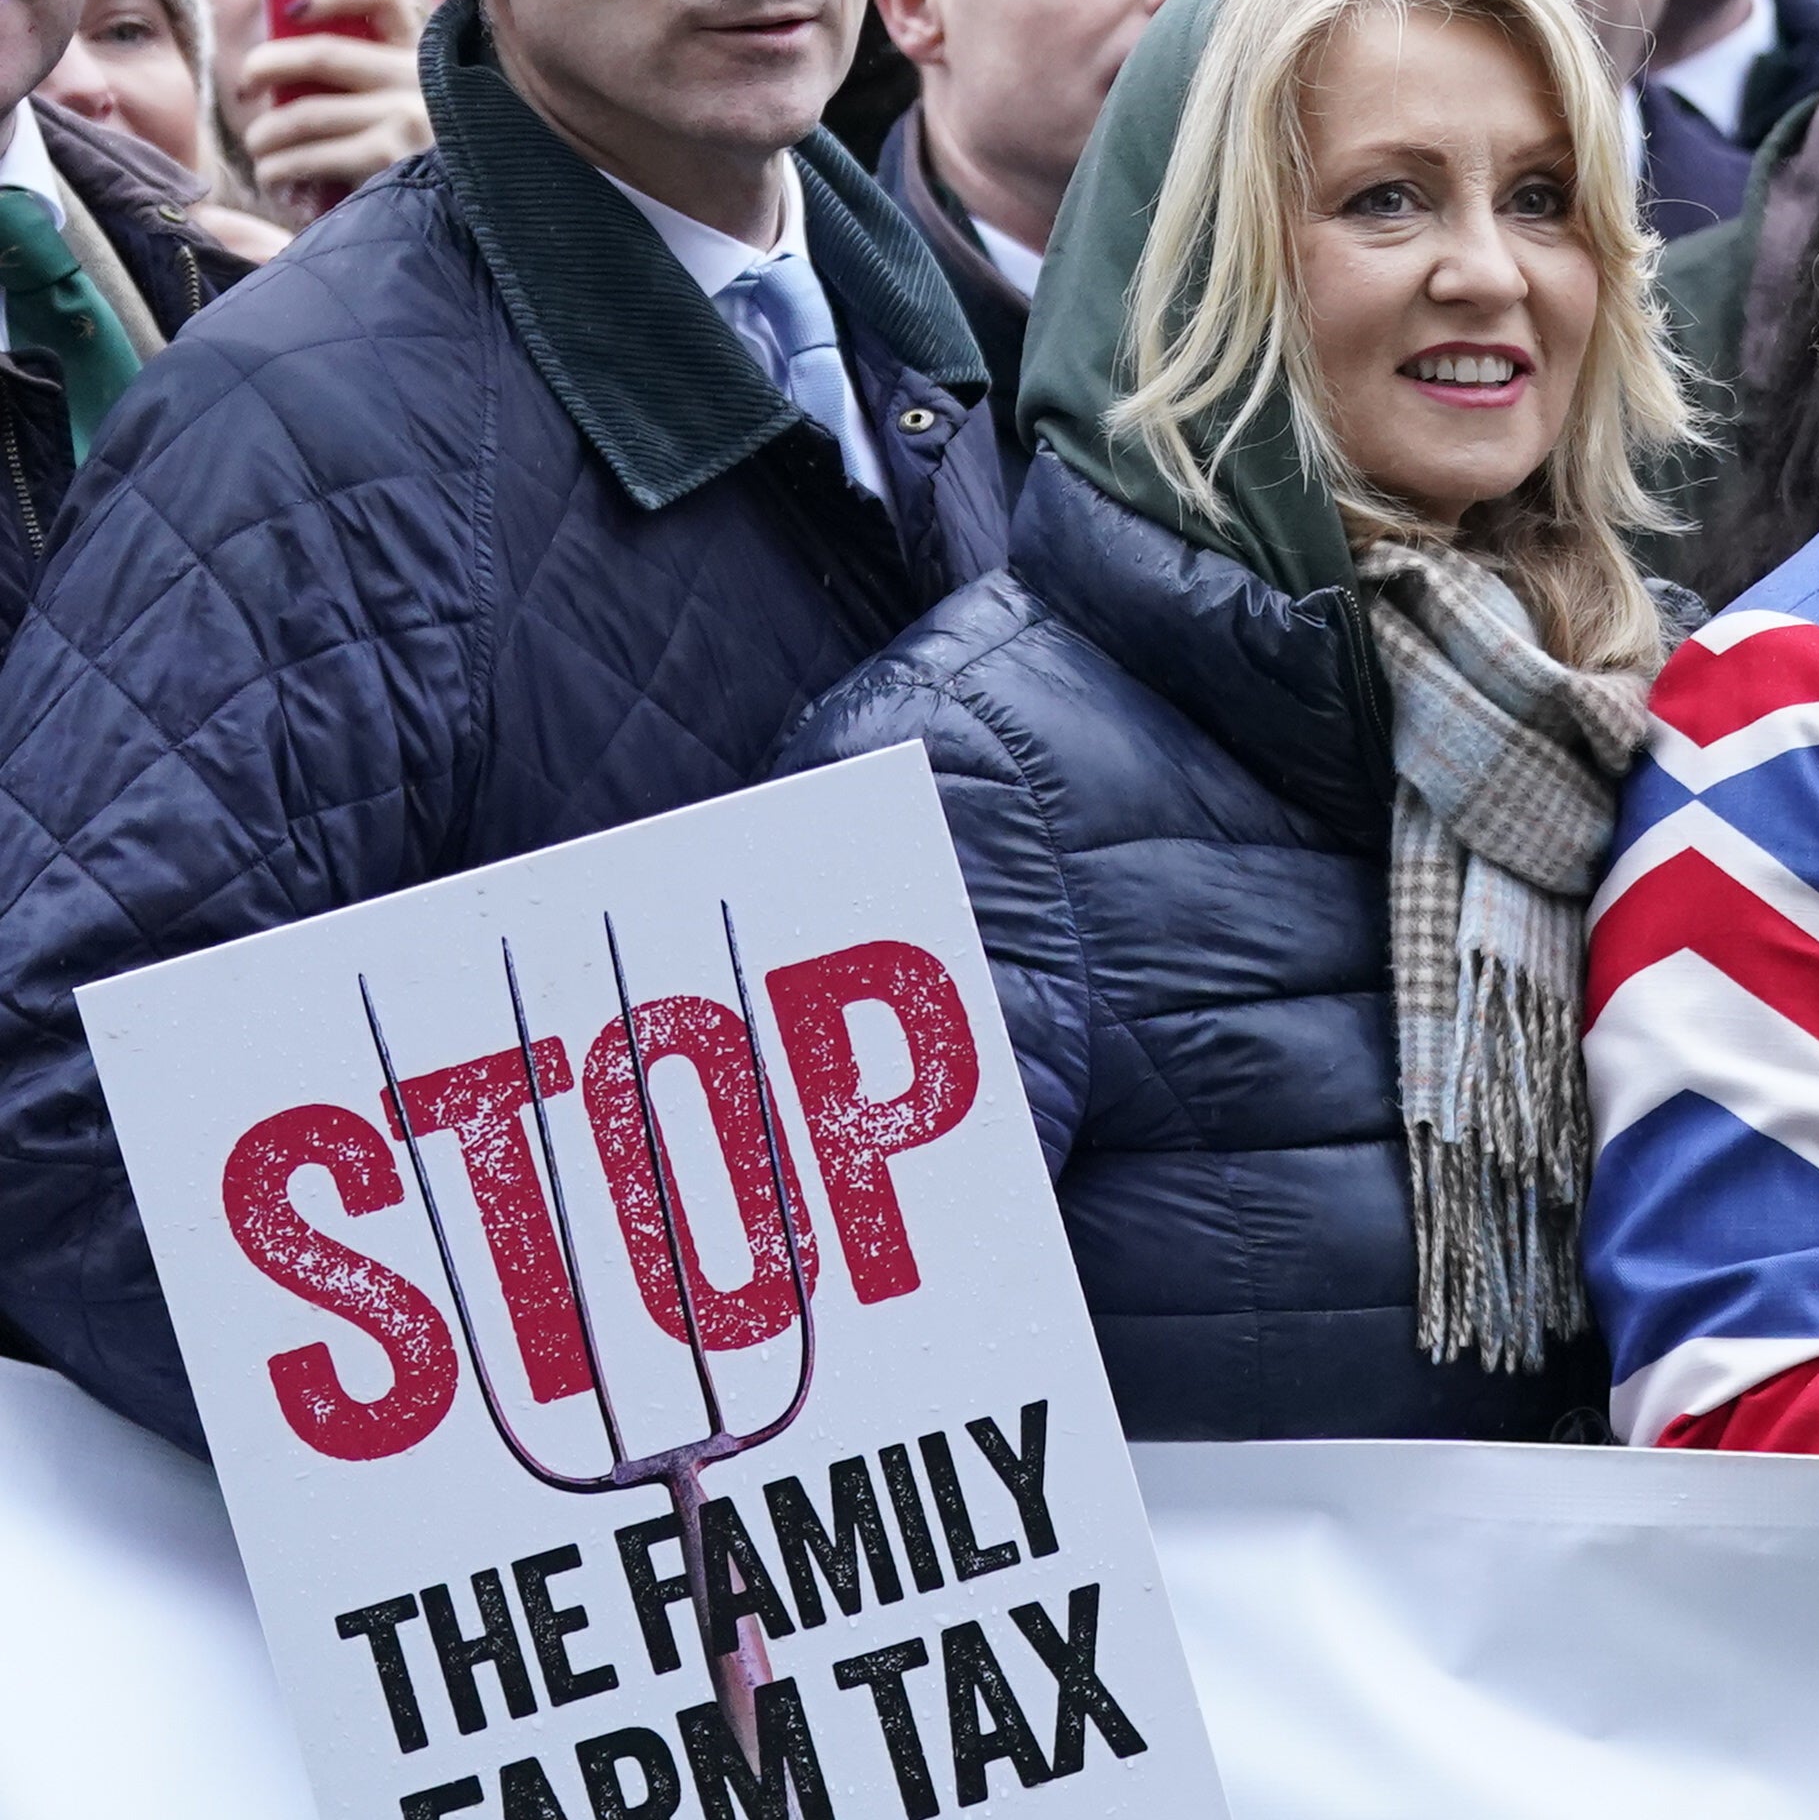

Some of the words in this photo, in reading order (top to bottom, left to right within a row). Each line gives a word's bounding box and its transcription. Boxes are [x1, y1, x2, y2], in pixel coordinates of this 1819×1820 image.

[220, 939, 980, 1463] STOP
[334, 1541, 619, 1754] THE
[613, 1399, 1061, 1676] FAMILY
[834, 1582, 1148, 1820] TAX
